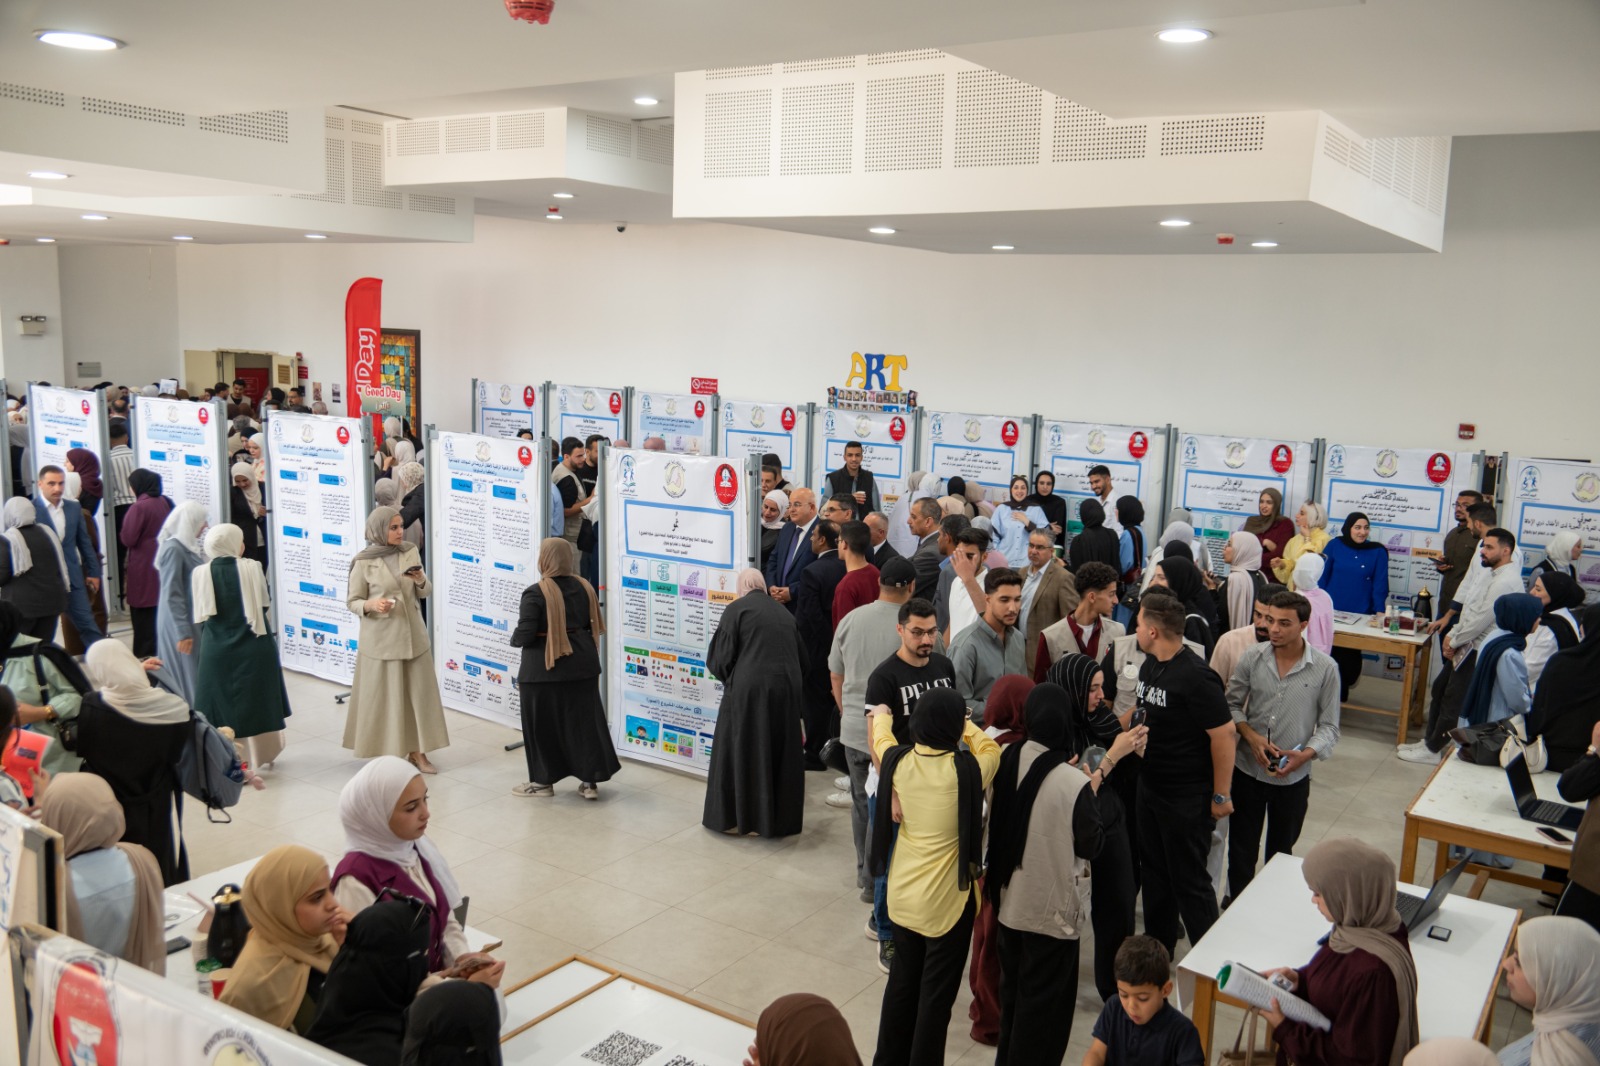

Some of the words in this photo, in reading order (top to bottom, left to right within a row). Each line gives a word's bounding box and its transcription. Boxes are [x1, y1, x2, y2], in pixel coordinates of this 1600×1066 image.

[354, 327, 377, 384] Day
[845, 351, 908, 392] ART
[365, 385, 384, 397] Good
[386, 386, 401, 401] Day
